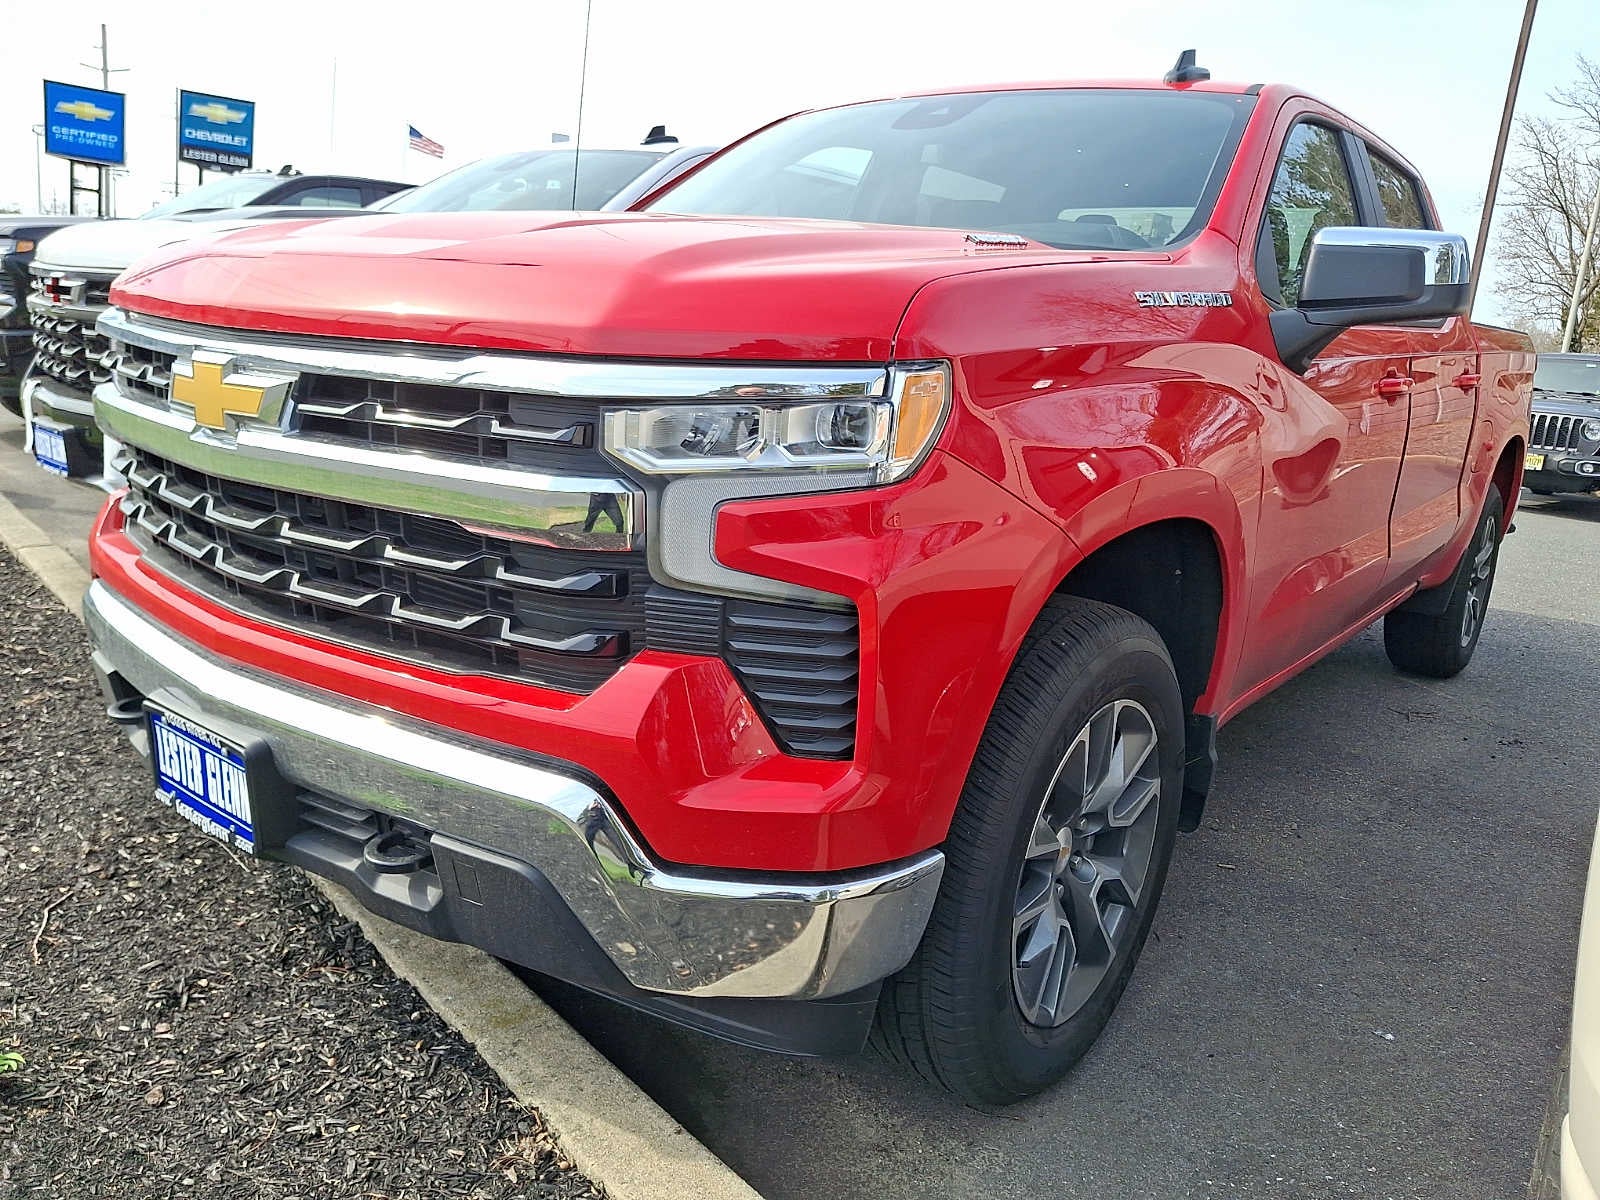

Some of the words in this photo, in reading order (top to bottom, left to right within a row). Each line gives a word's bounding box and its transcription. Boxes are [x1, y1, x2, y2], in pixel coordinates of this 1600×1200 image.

[52, 126, 118, 142] CERTIFIED
[185, 129, 248, 146] CHEVROLET
[183, 148, 217, 162] LESTER
[217, 154, 248, 167] GLENN
[155, 724, 204, 796] LESTER
[205, 752, 252, 825] GLENN
